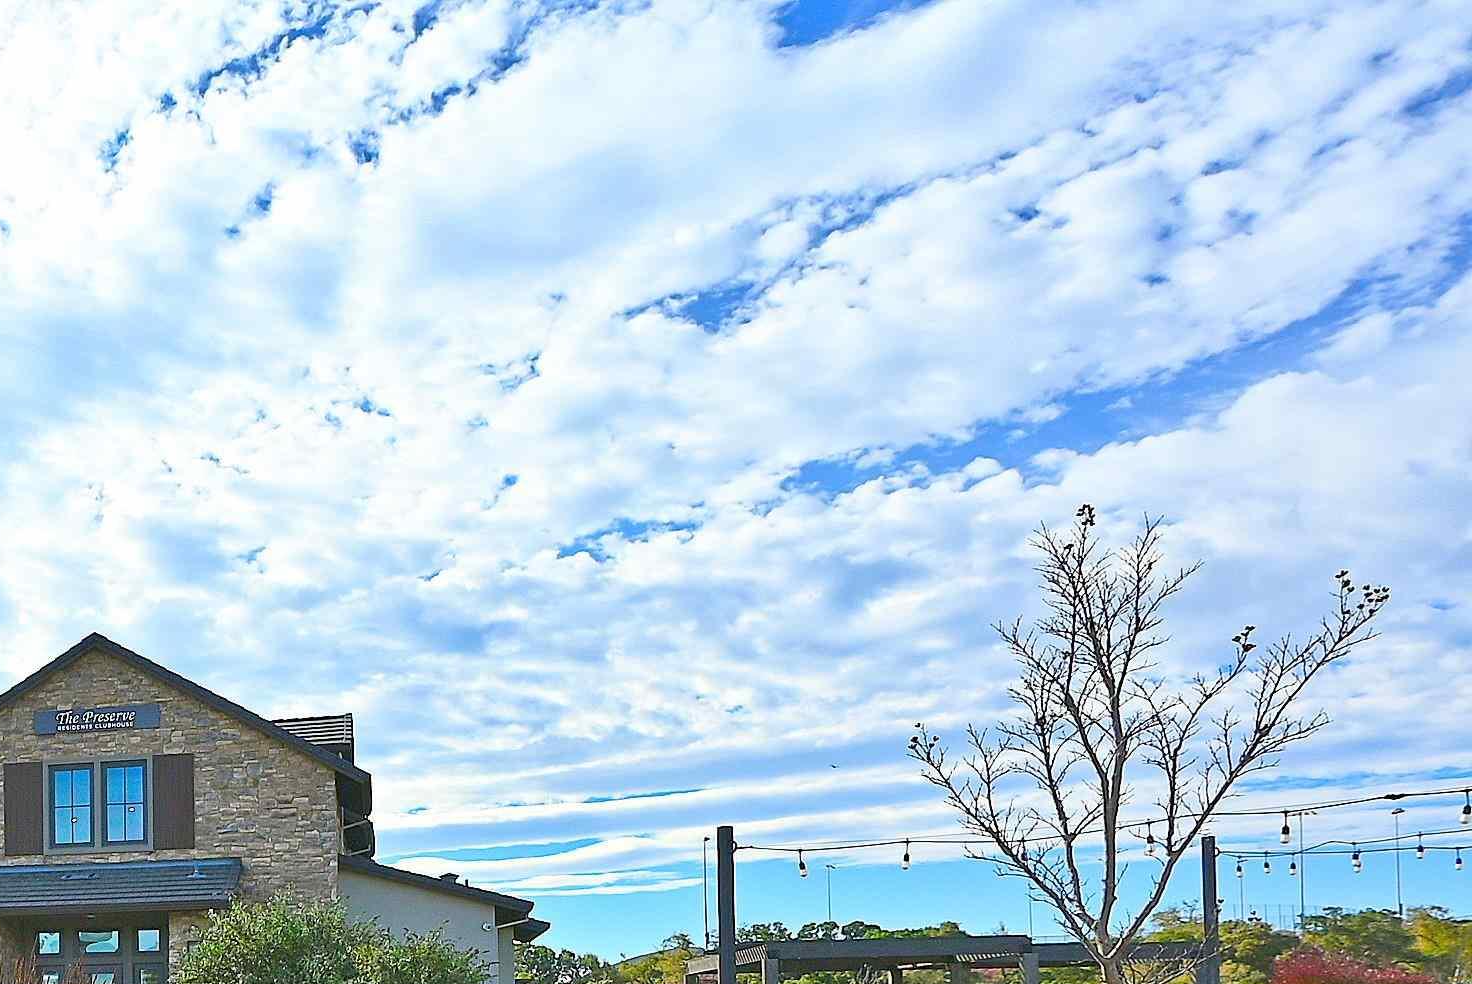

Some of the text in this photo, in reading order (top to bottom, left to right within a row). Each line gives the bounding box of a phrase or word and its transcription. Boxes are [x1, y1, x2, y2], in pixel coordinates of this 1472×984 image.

[55, 711, 136, 725] The Preserve
[94, 722, 134, 730] CLUBHOUSE
